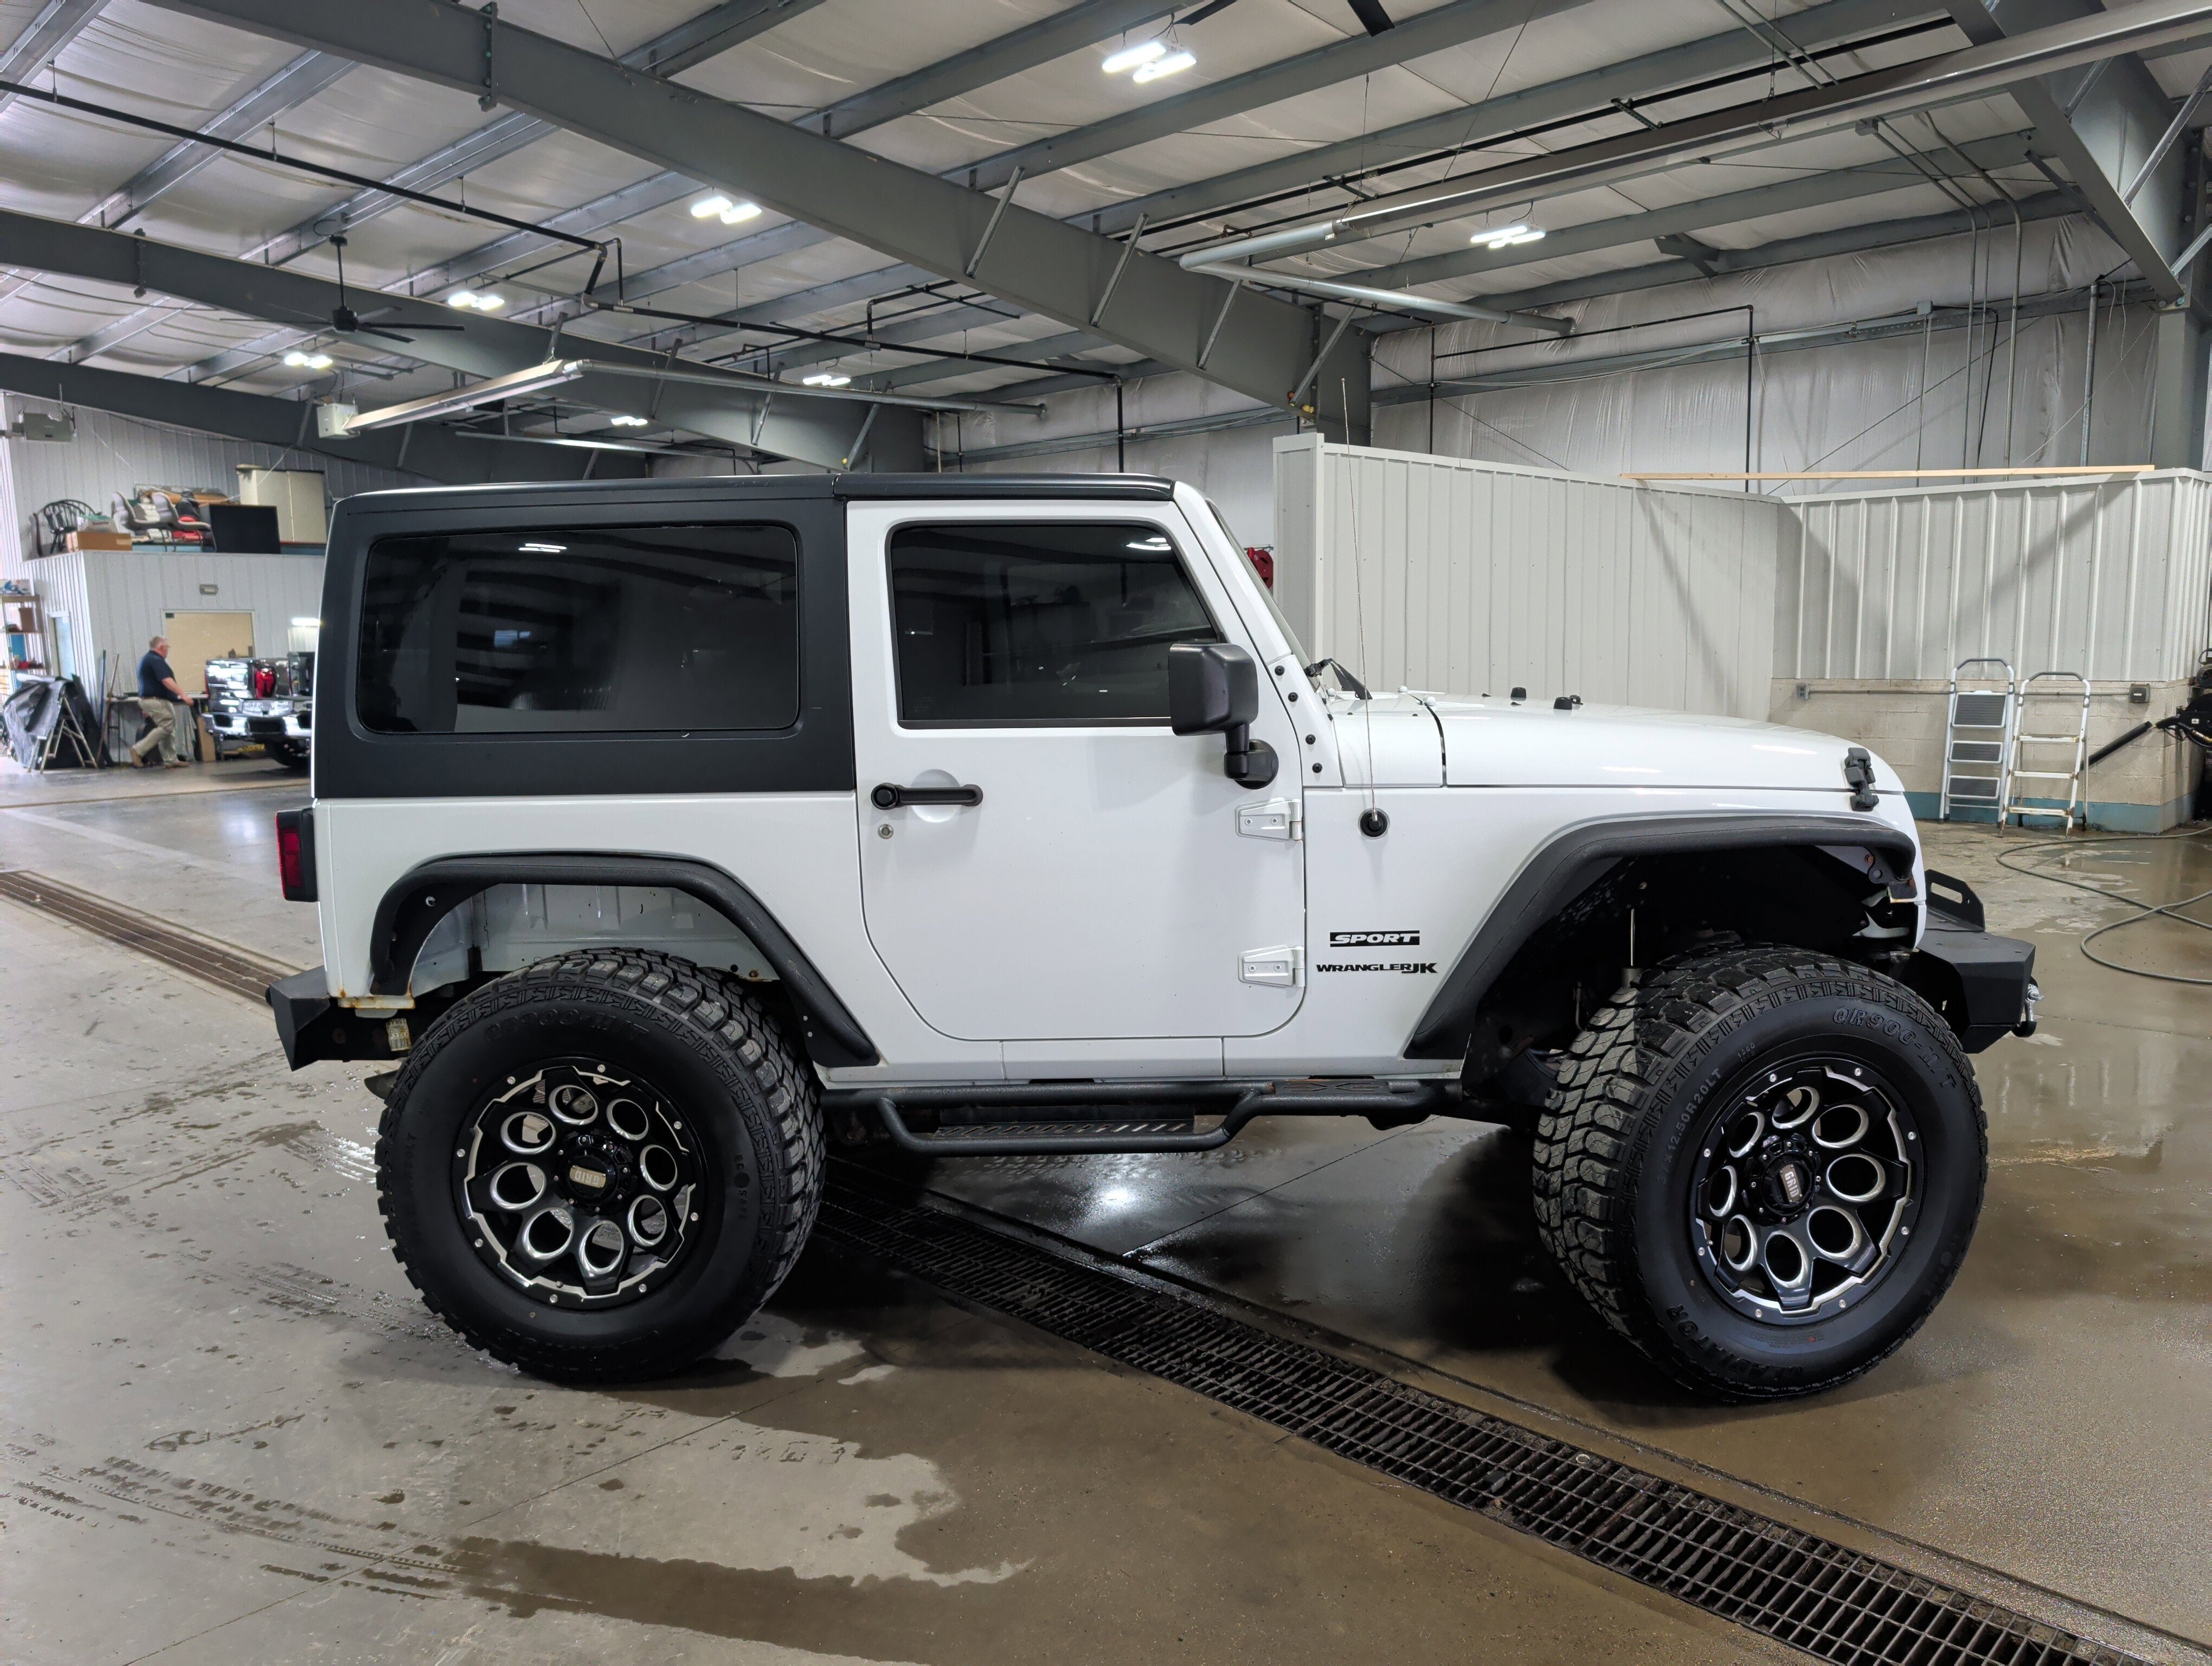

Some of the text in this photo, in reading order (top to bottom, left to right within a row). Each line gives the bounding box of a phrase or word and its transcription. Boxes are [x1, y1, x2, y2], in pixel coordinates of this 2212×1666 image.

[1330, 932, 1419, 945] SPORT
[1832, 1006, 1957, 1089] QR900-M/T
[574, 1170, 600, 1186] GRID
[1784, 1170, 1799, 1198] GRID
